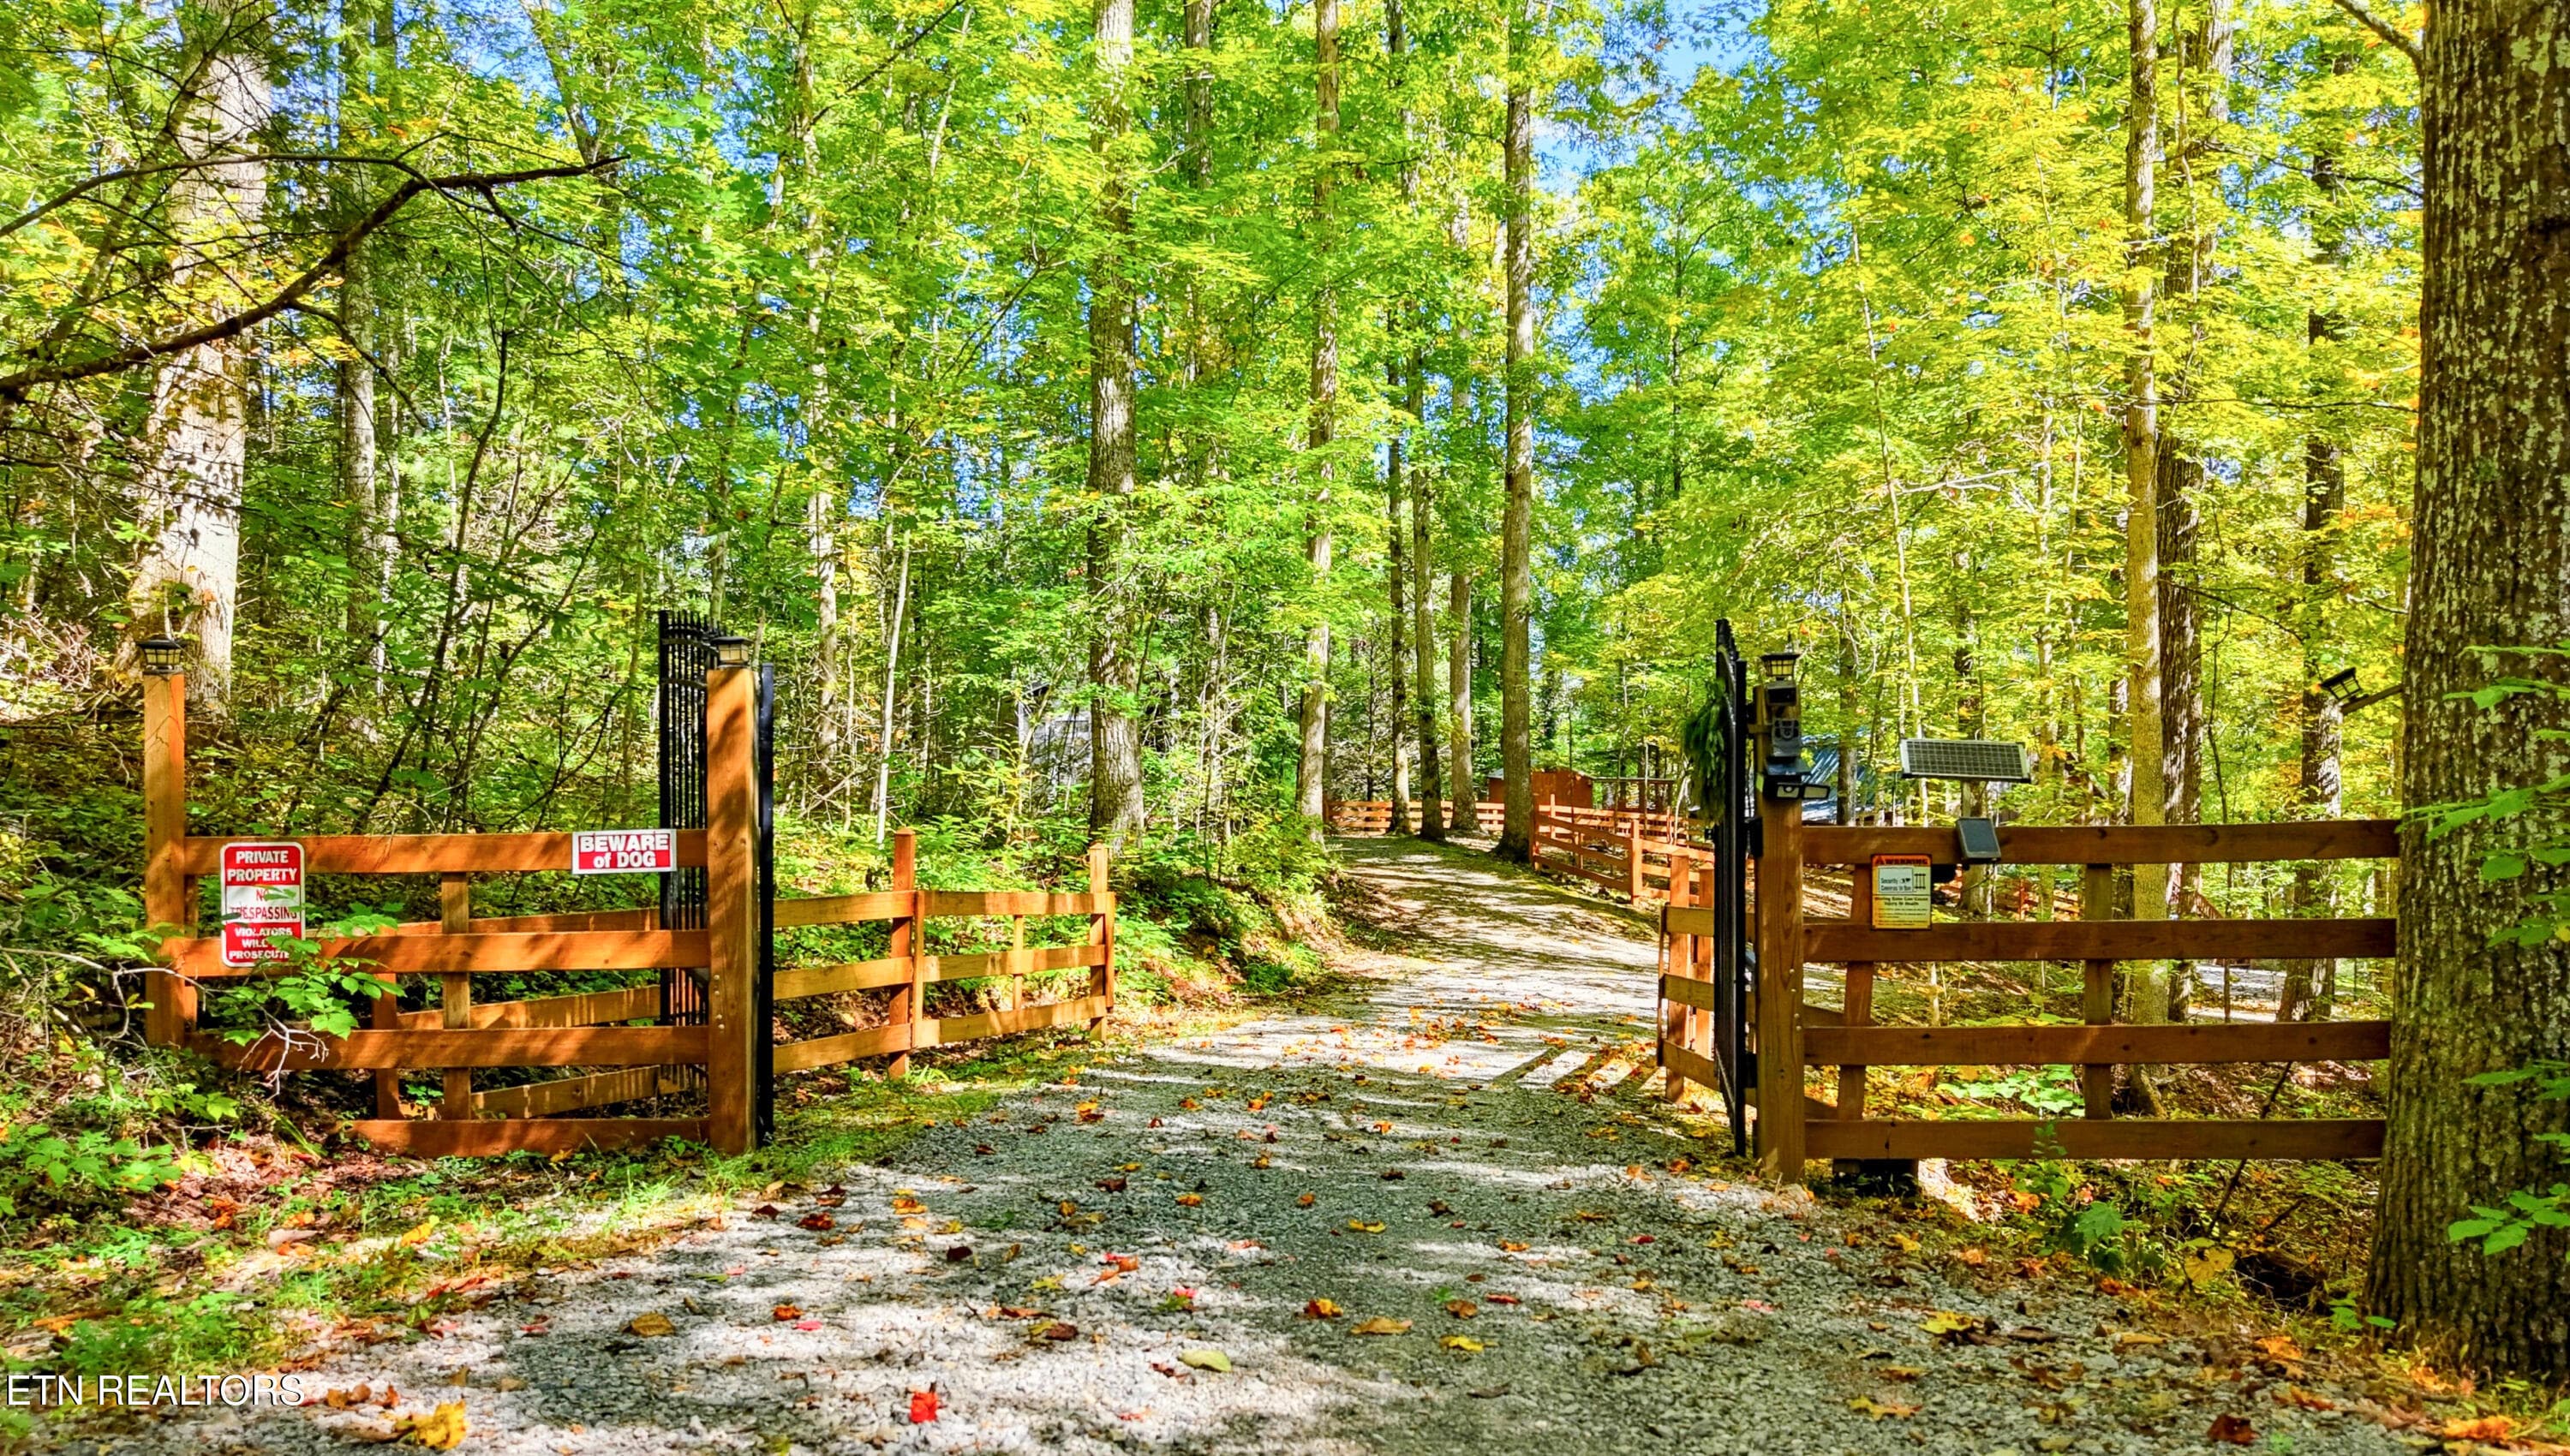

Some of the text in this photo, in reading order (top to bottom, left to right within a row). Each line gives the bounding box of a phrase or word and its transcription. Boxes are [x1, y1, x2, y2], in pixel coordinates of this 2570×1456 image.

[580, 833, 668, 852] BEWARE
[236, 850, 289, 864] PRIVATE
[593, 850, 656, 868] of DOG
[227, 868, 297, 882] PROPERTY
[235, 927, 293, 937] VIOLATORS
[229, 950, 290, 960] PROSECUTE
